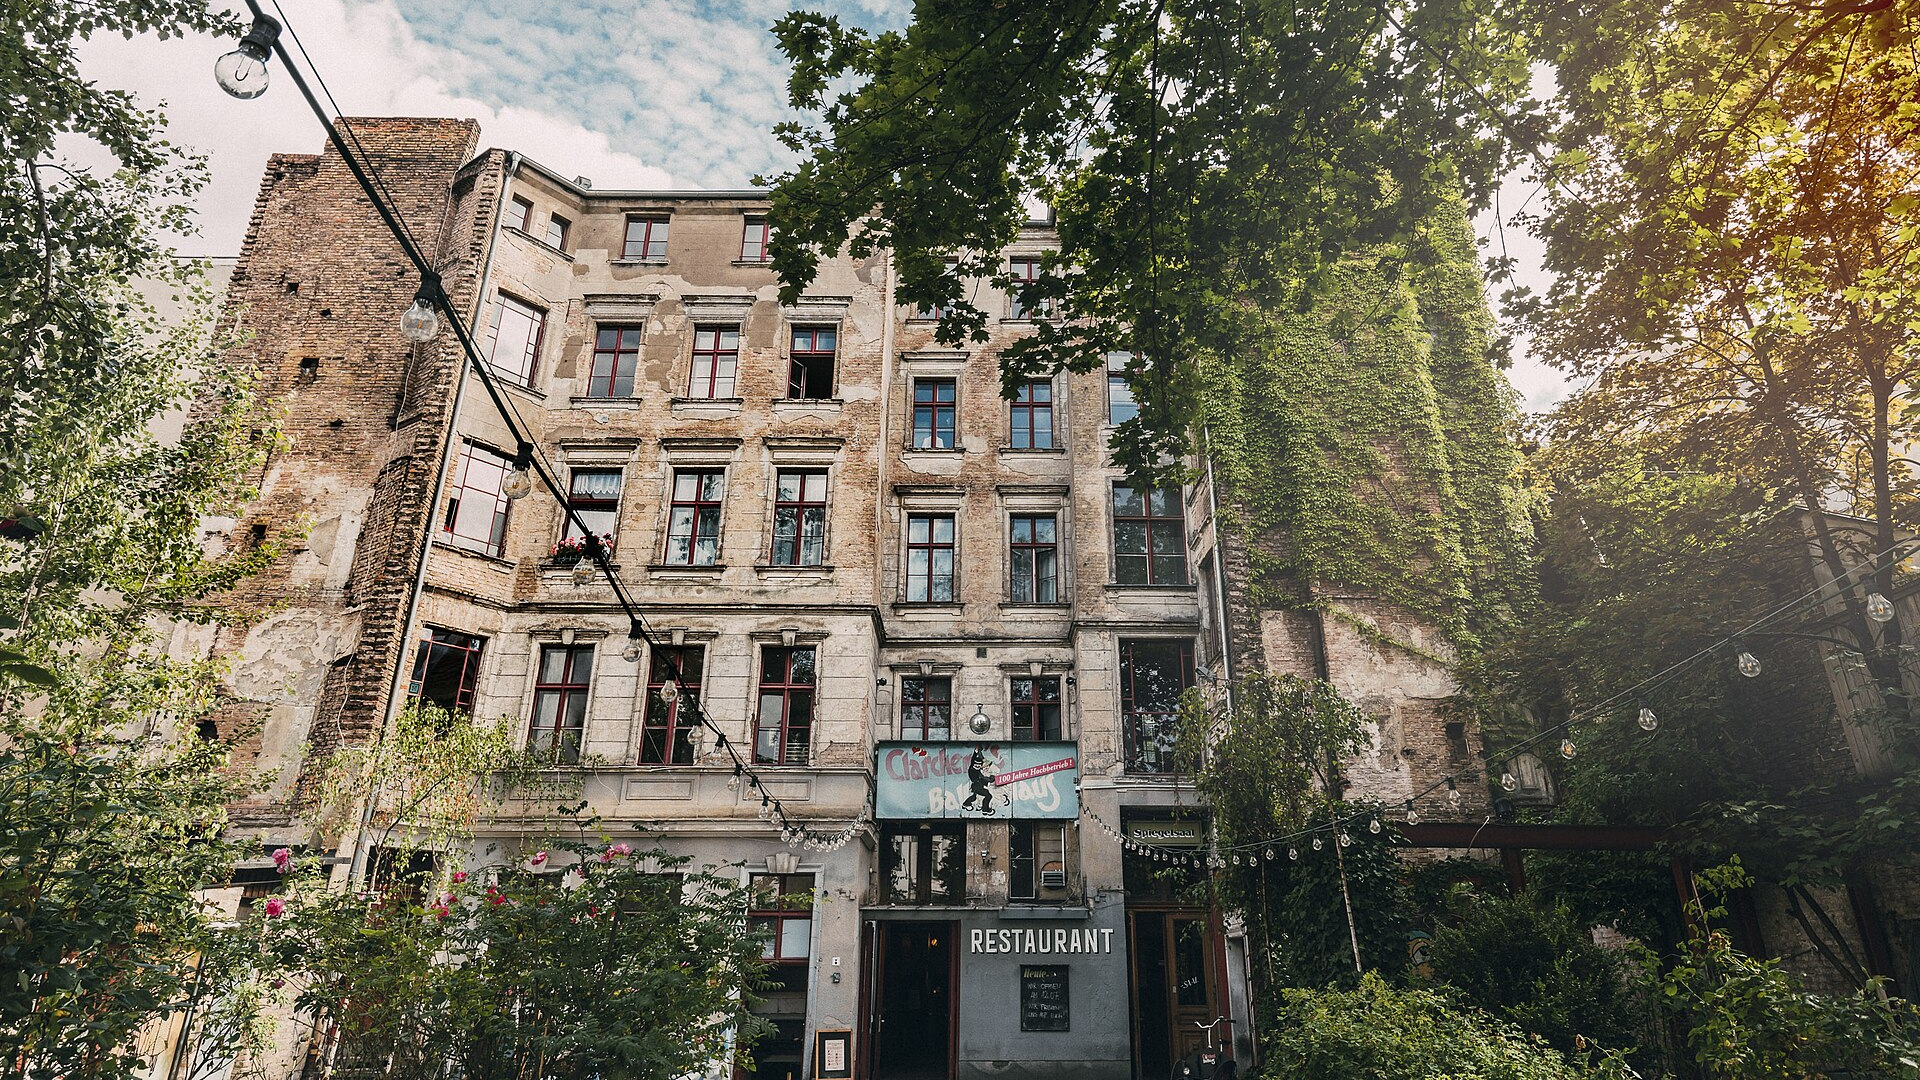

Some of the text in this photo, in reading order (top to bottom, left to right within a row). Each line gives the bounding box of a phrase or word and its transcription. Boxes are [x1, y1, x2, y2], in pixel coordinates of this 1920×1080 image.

[998, 774, 1011, 784] 100
[1011, 771, 1029, 782] Jahre
[1133, 828, 1195, 839] Spiegelsaal
[970, 928, 1115, 954] RESTAURANT
